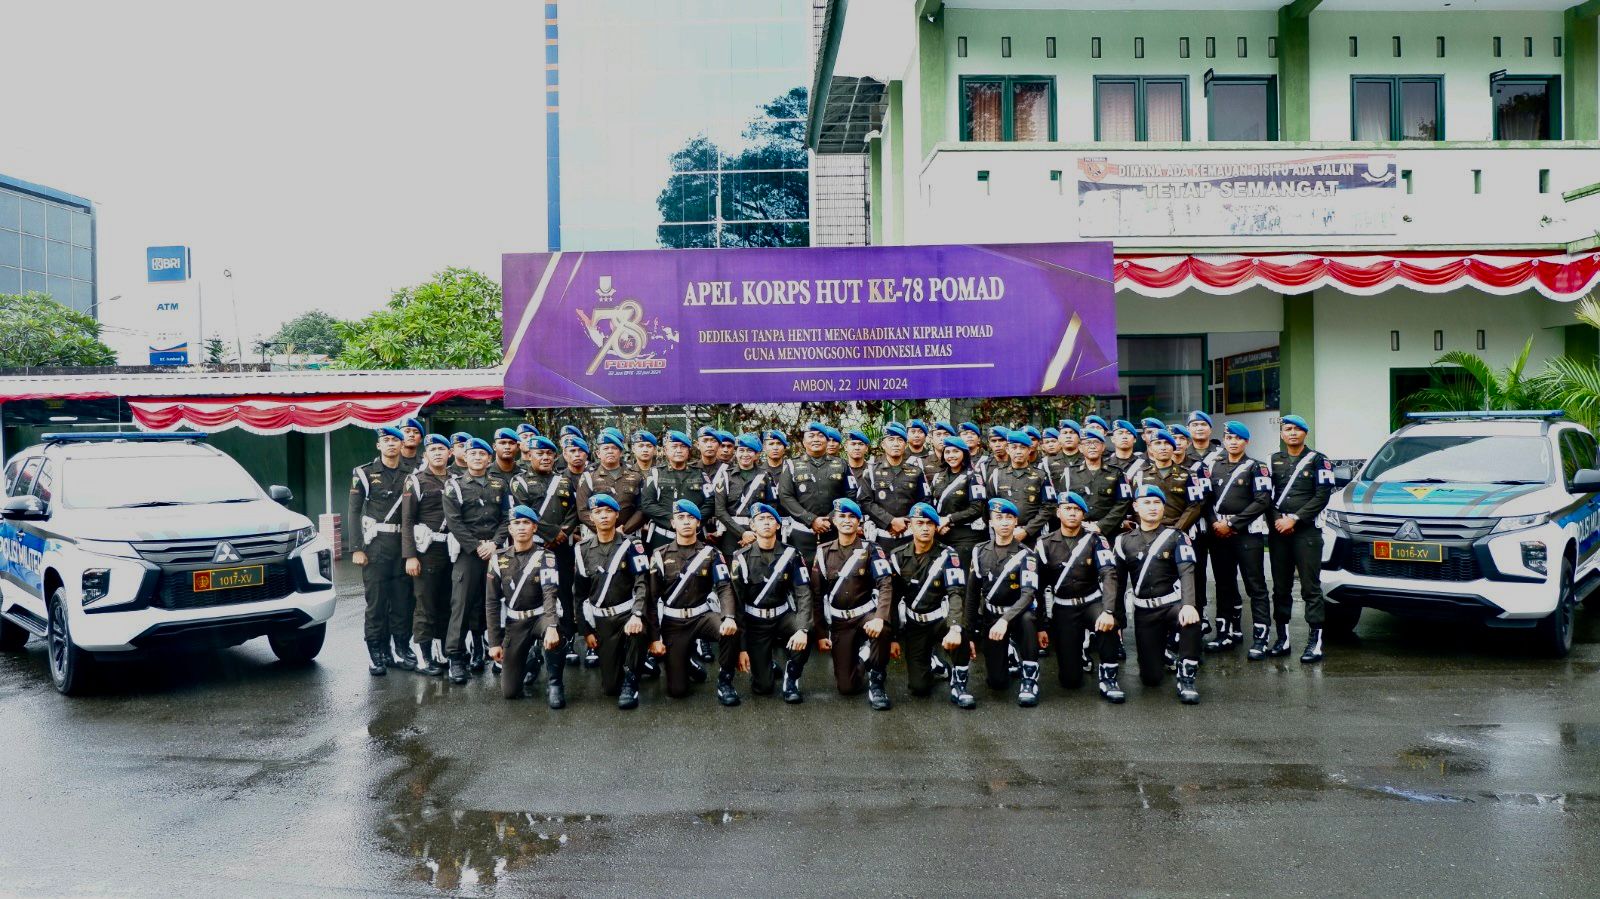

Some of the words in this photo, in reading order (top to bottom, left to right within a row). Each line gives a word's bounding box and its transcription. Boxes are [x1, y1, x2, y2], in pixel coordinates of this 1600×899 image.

[1118, 163, 1162, 177] DIMANA
[1167, 163, 1189, 177] ADA
[1192, 163, 1247, 177] KEMAUAN
[1292, 163, 1314, 176] ADA
[1318, 162, 1354, 176] JALAN
[1142, 182, 1213, 199] TETAP
[1219, 181, 1340, 198] SEMANGAT
[163, 257, 180, 269] BRI
[683, 281, 738, 306] APEL
[742, 279, 811, 305] KORPS
[816, 278, 863, 304] HUT
[867, 277, 924, 303] KE-78
[929, 276, 1005, 302] POMAD
[157, 303, 179, 311] ATM
[698, 330, 749, 343] DEDIKASI
[751, 329, 786, 342] TANPA
[787, 328, 822, 342] HENTI
[824, 327, 910, 341] MENGABADIKAN
[912, 326, 954, 339] KIPRAH
[955, 324, 994, 338] POMAD
[743, 347, 775, 361] GUNA
[777, 346, 861, 360] MENYONGSONG
[863, 345, 922, 359] INDONESIA
[924, 344, 953, 358] EMAS
[604, 359, 666, 370] POMAD
[792, 378, 837, 393] AMBON,
[838, 379, 852, 391] 22
[856, 378, 880, 391] JUNI
[882, 377, 909, 390] 2024
[1396, 548, 1430, 559] 1016-XV
[220, 572, 253, 586] 1017-XV
